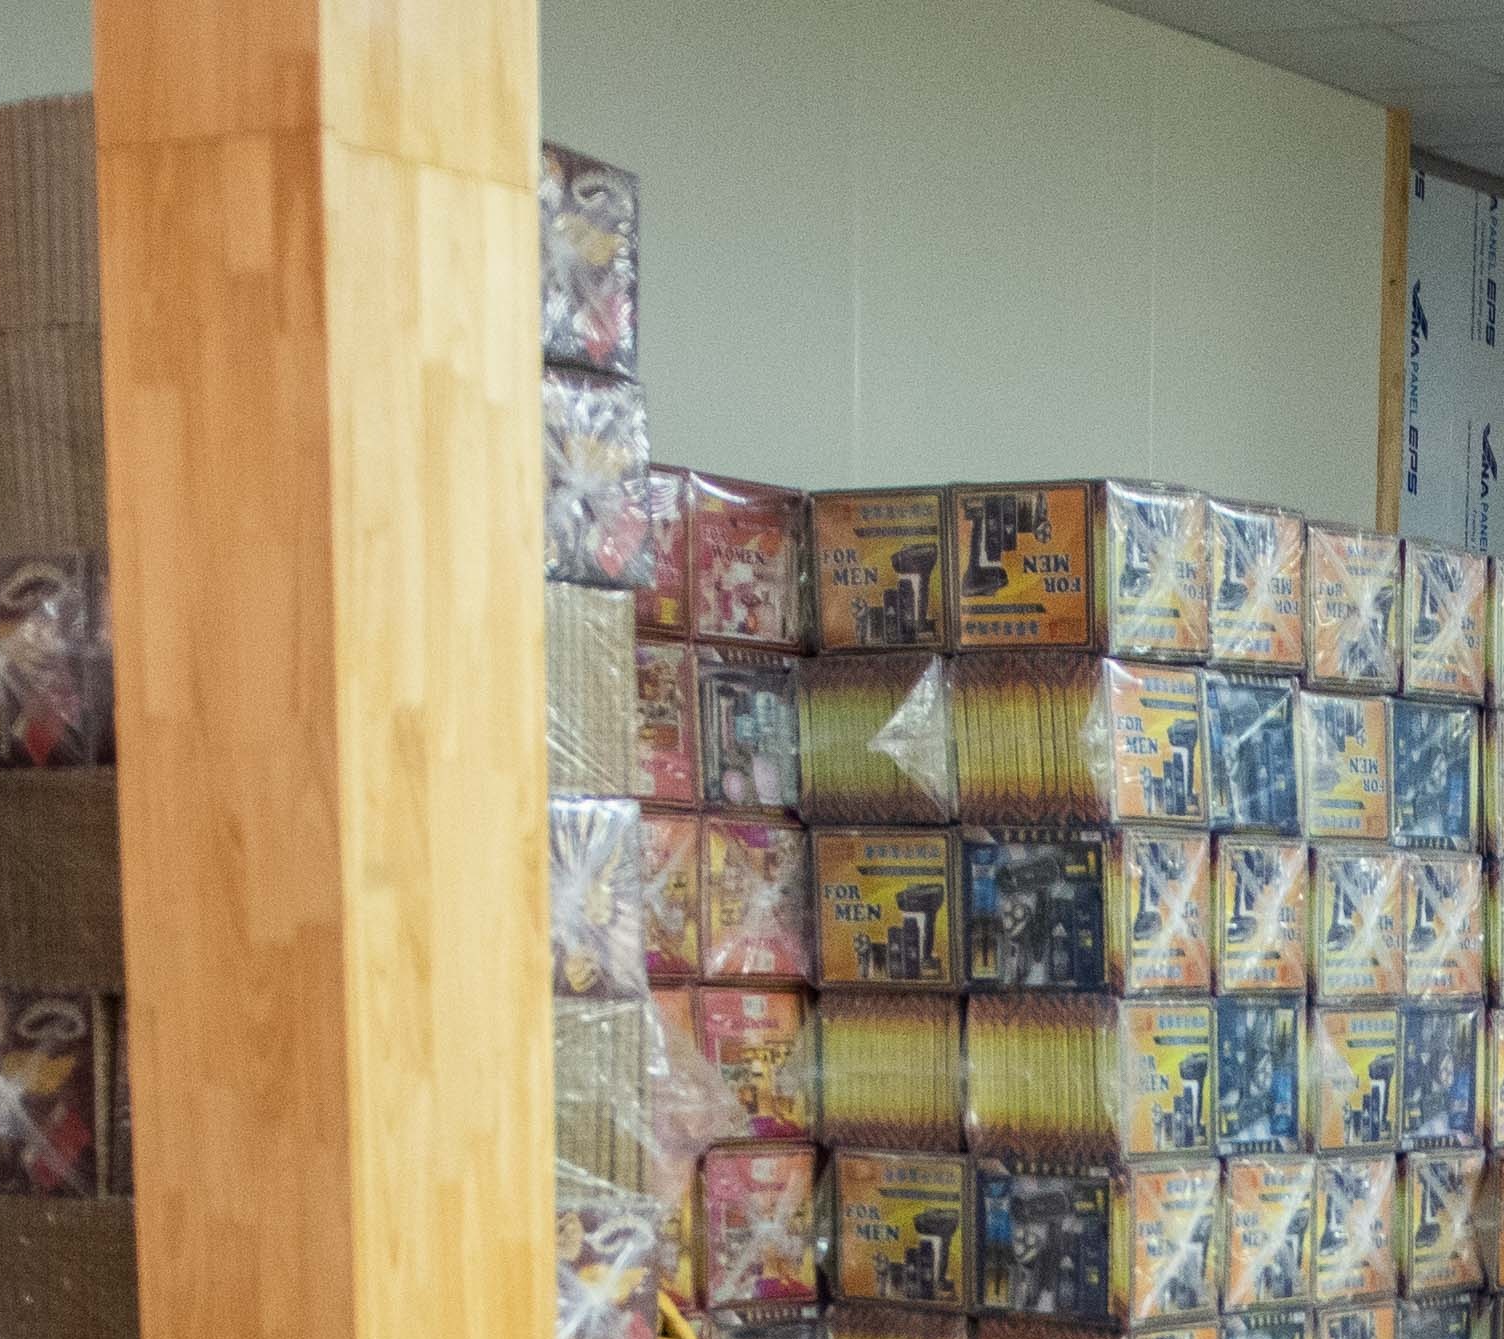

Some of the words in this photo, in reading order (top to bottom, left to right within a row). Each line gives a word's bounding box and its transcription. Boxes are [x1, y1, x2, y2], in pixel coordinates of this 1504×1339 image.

[1485, 278, 1497, 349] EPS
[1407, 425, 1419, 496] EPS
[823, 549, 856, 564] FOR
[1023, 554, 1070, 573] MEN
[833, 567, 878, 585] MEN
[1043, 577, 1080, 593] FOR
[1116, 715, 1143, 732] FOR
[1125, 735, 1158, 754] MEN
[1349, 757, 1378, 774] MEN
[824, 885, 860, 899] FOR
[835, 903, 881, 921] MEN
[856, 1222, 899, 1241] MEN
